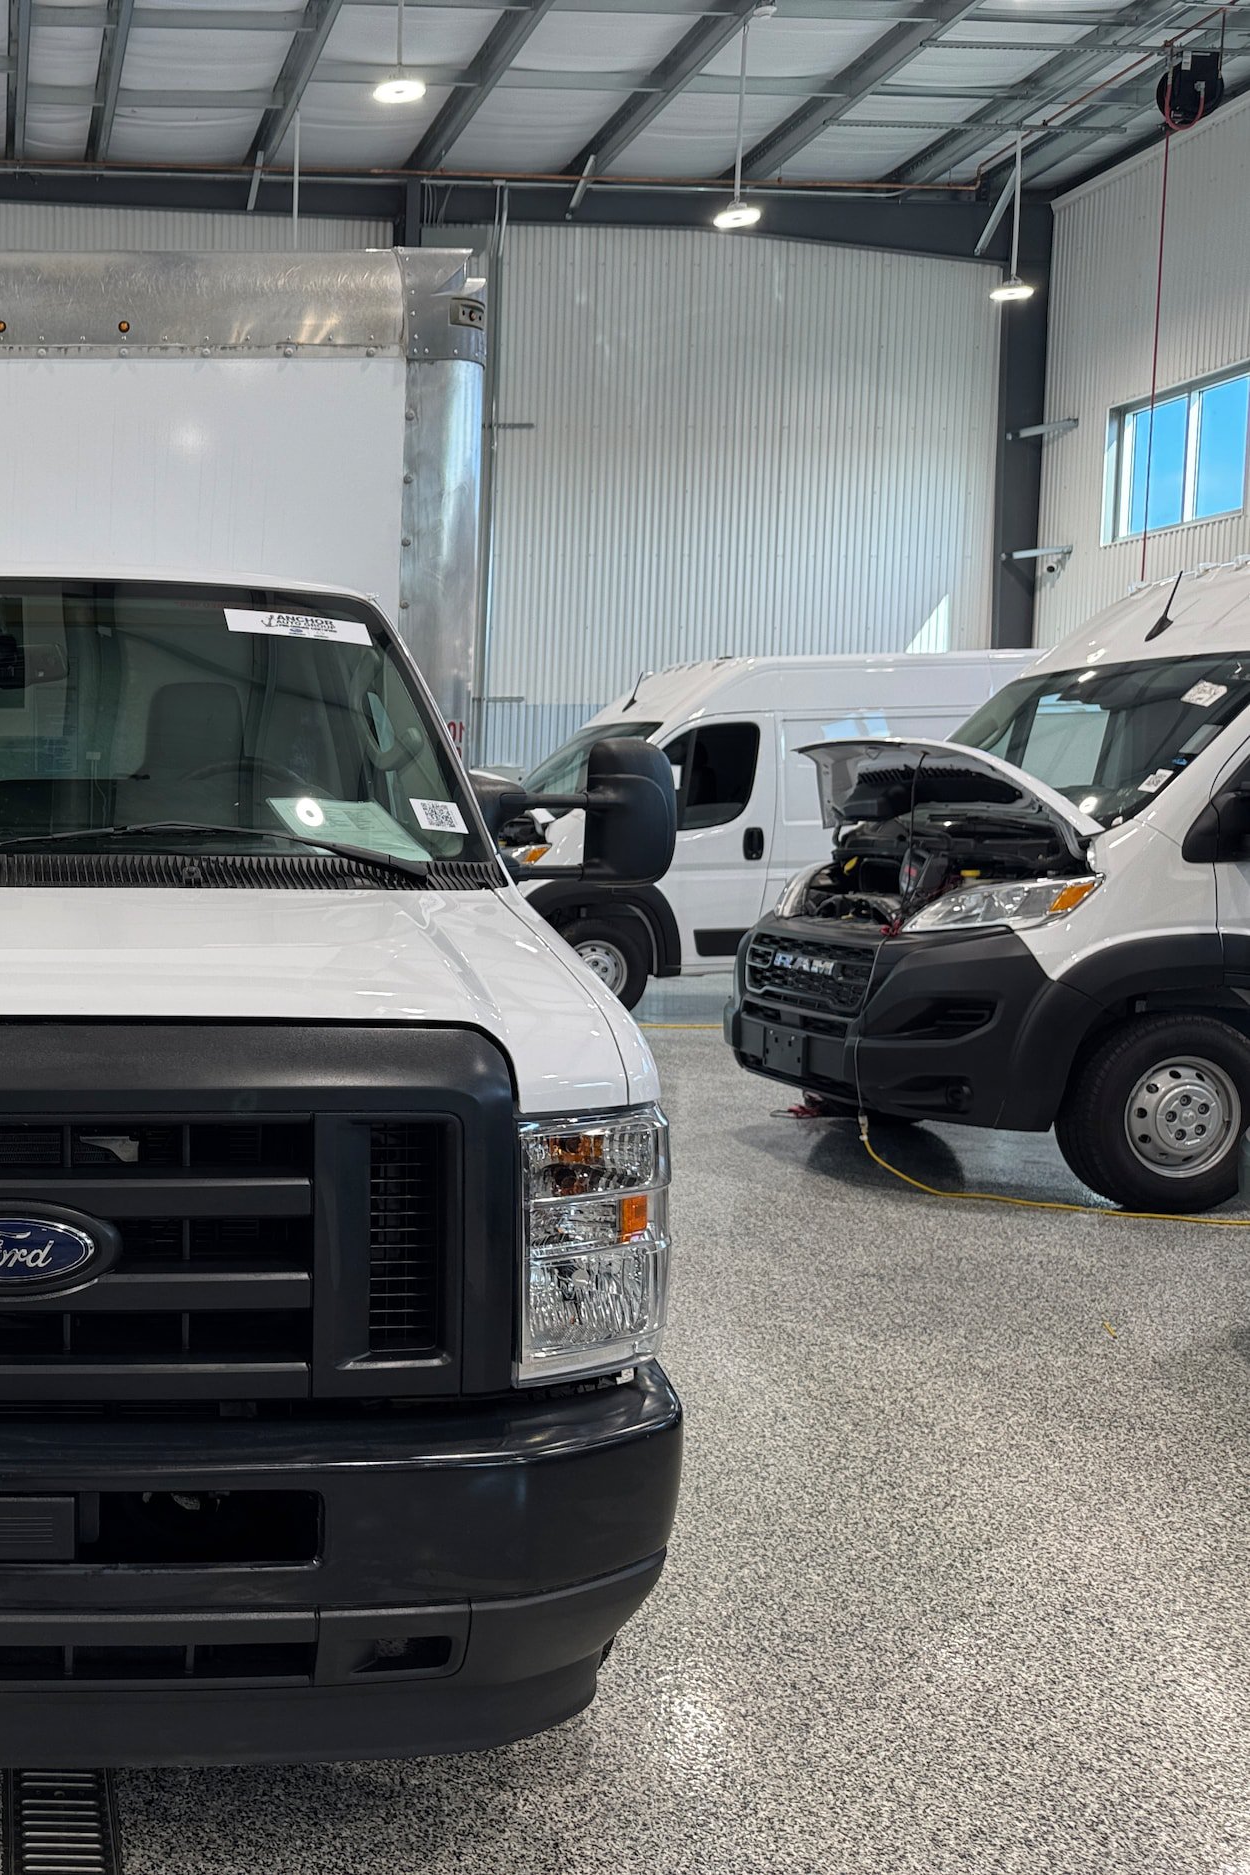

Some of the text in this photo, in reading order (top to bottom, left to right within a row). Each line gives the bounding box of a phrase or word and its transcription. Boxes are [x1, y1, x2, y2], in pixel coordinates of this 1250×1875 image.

[276, 614, 334, 625] ANCHOR
[304, 622, 336, 630] GROUP
[773, 952, 835, 976] RAM
